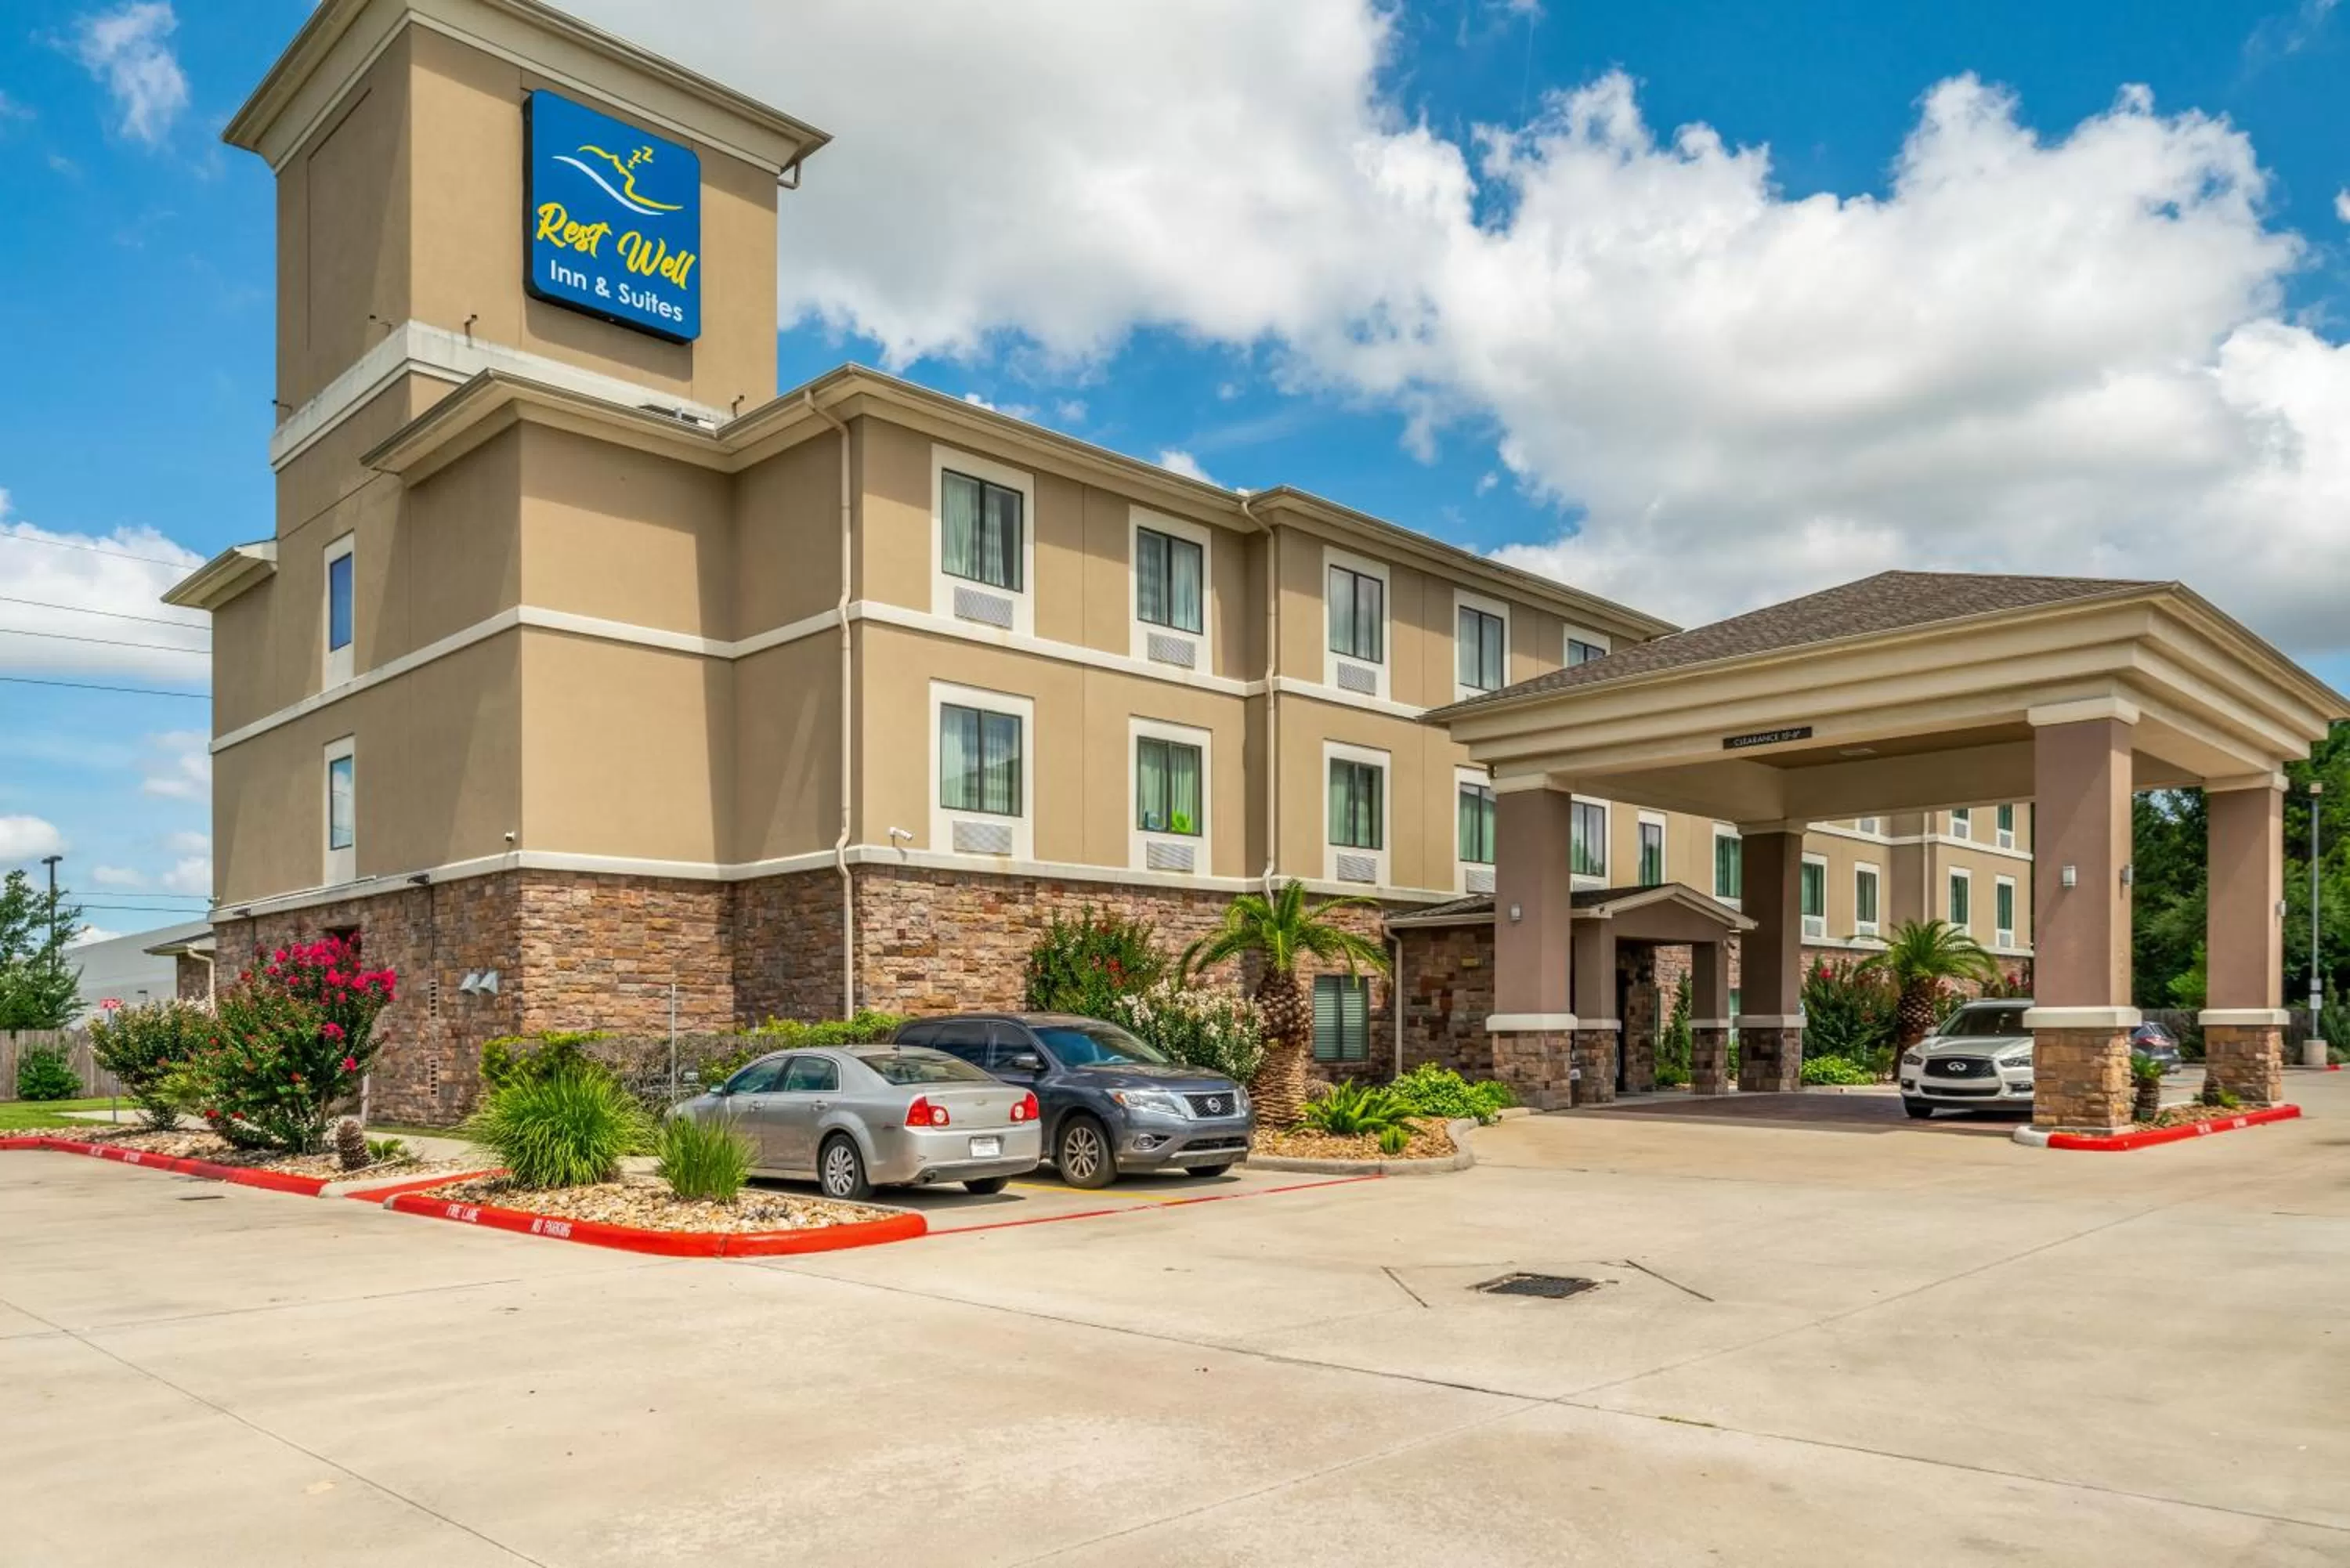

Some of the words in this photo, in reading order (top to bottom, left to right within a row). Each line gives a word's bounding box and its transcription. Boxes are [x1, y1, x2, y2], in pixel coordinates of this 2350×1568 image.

[537, 202, 612, 260] Rest
[616, 230, 696, 290] Well
[551, 259, 587, 291] Inn
[595, 276, 611, 299] &
[618, 282, 683, 323] Suites
